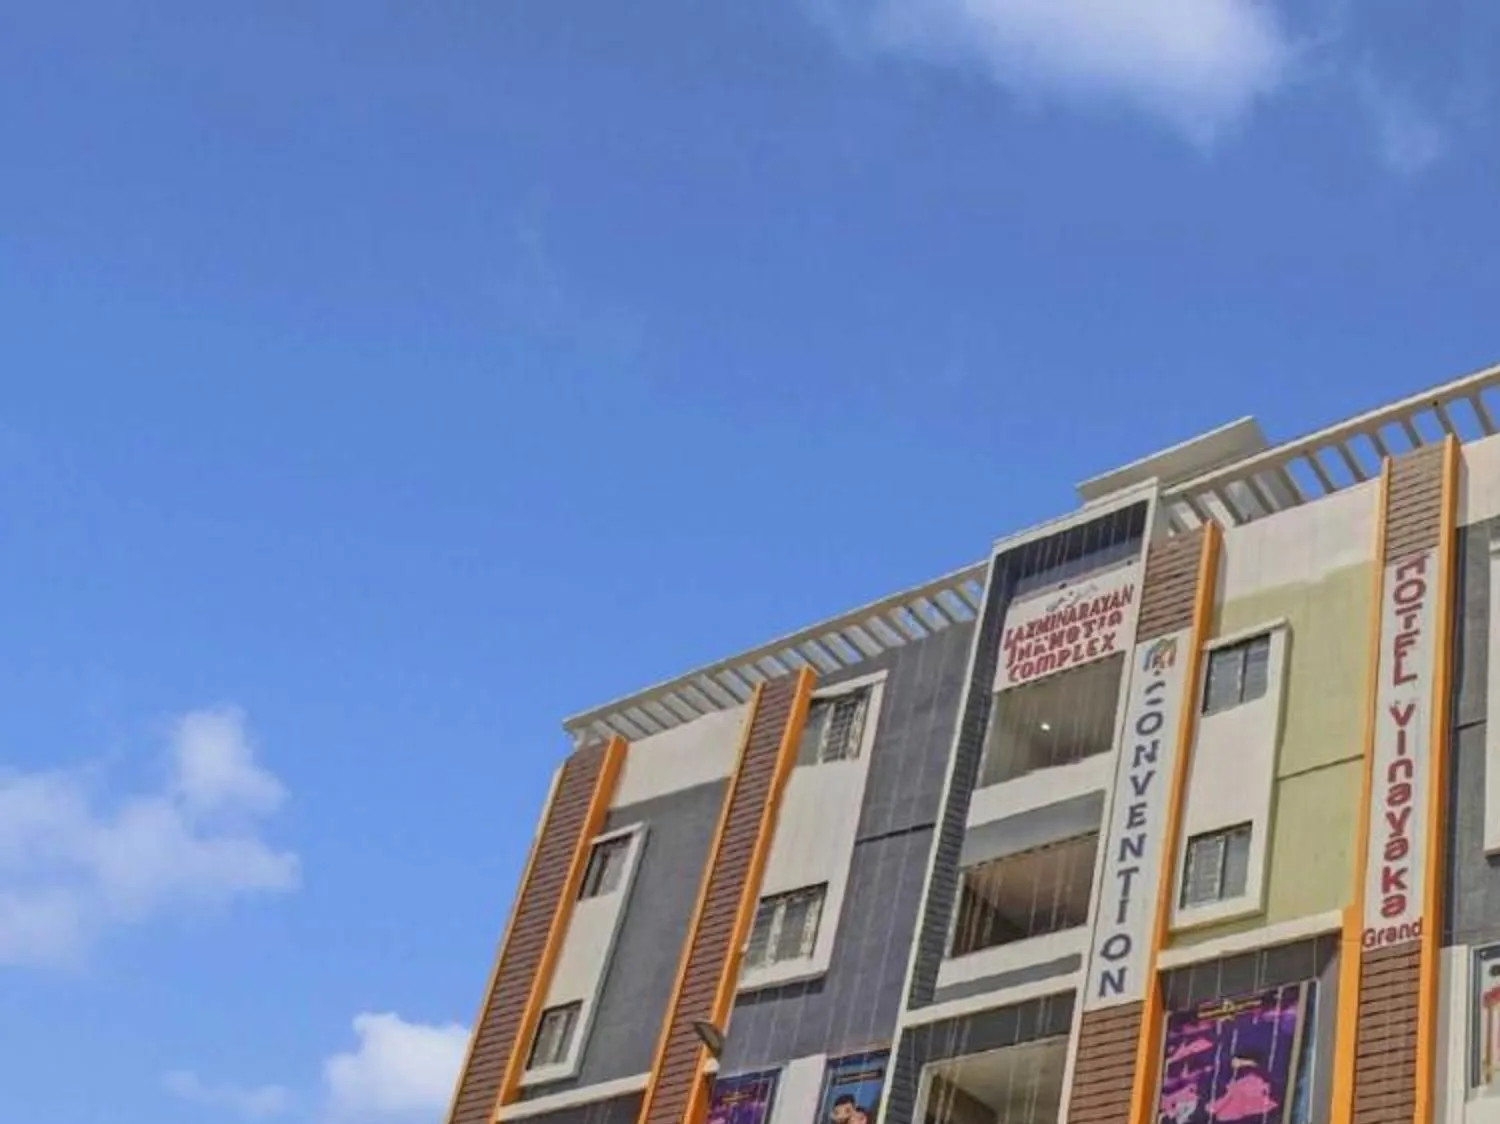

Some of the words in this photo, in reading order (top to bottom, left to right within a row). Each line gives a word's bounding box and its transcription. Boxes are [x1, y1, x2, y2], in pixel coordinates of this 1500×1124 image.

[1392, 551, 1430, 688] HOTEL
[1008, 632, 1116, 682] COMPLEX
[1361, 916, 1423, 948] Grand
